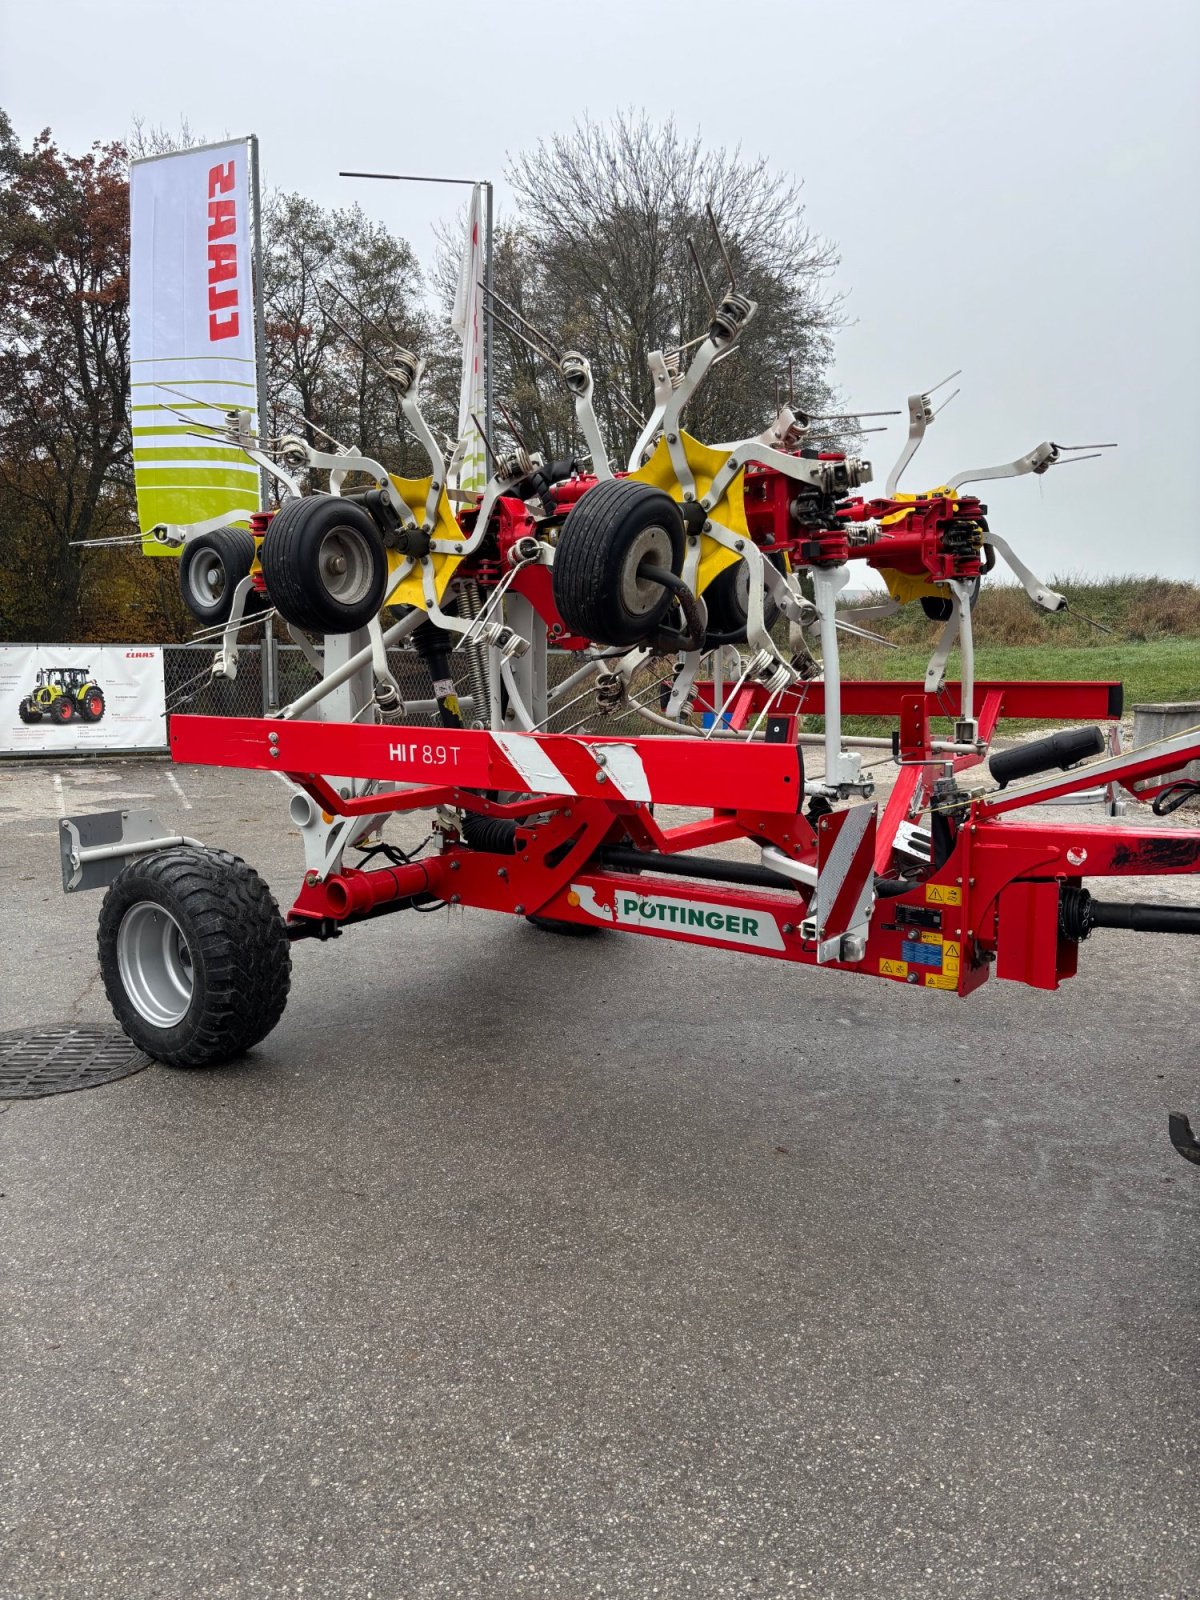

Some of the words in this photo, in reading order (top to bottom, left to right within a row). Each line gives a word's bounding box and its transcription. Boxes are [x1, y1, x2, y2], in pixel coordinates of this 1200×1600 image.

[422, 745, 446, 765] 8.9
[450, 746, 461, 766] T
[623, 898, 759, 937] PÖTTINGER
